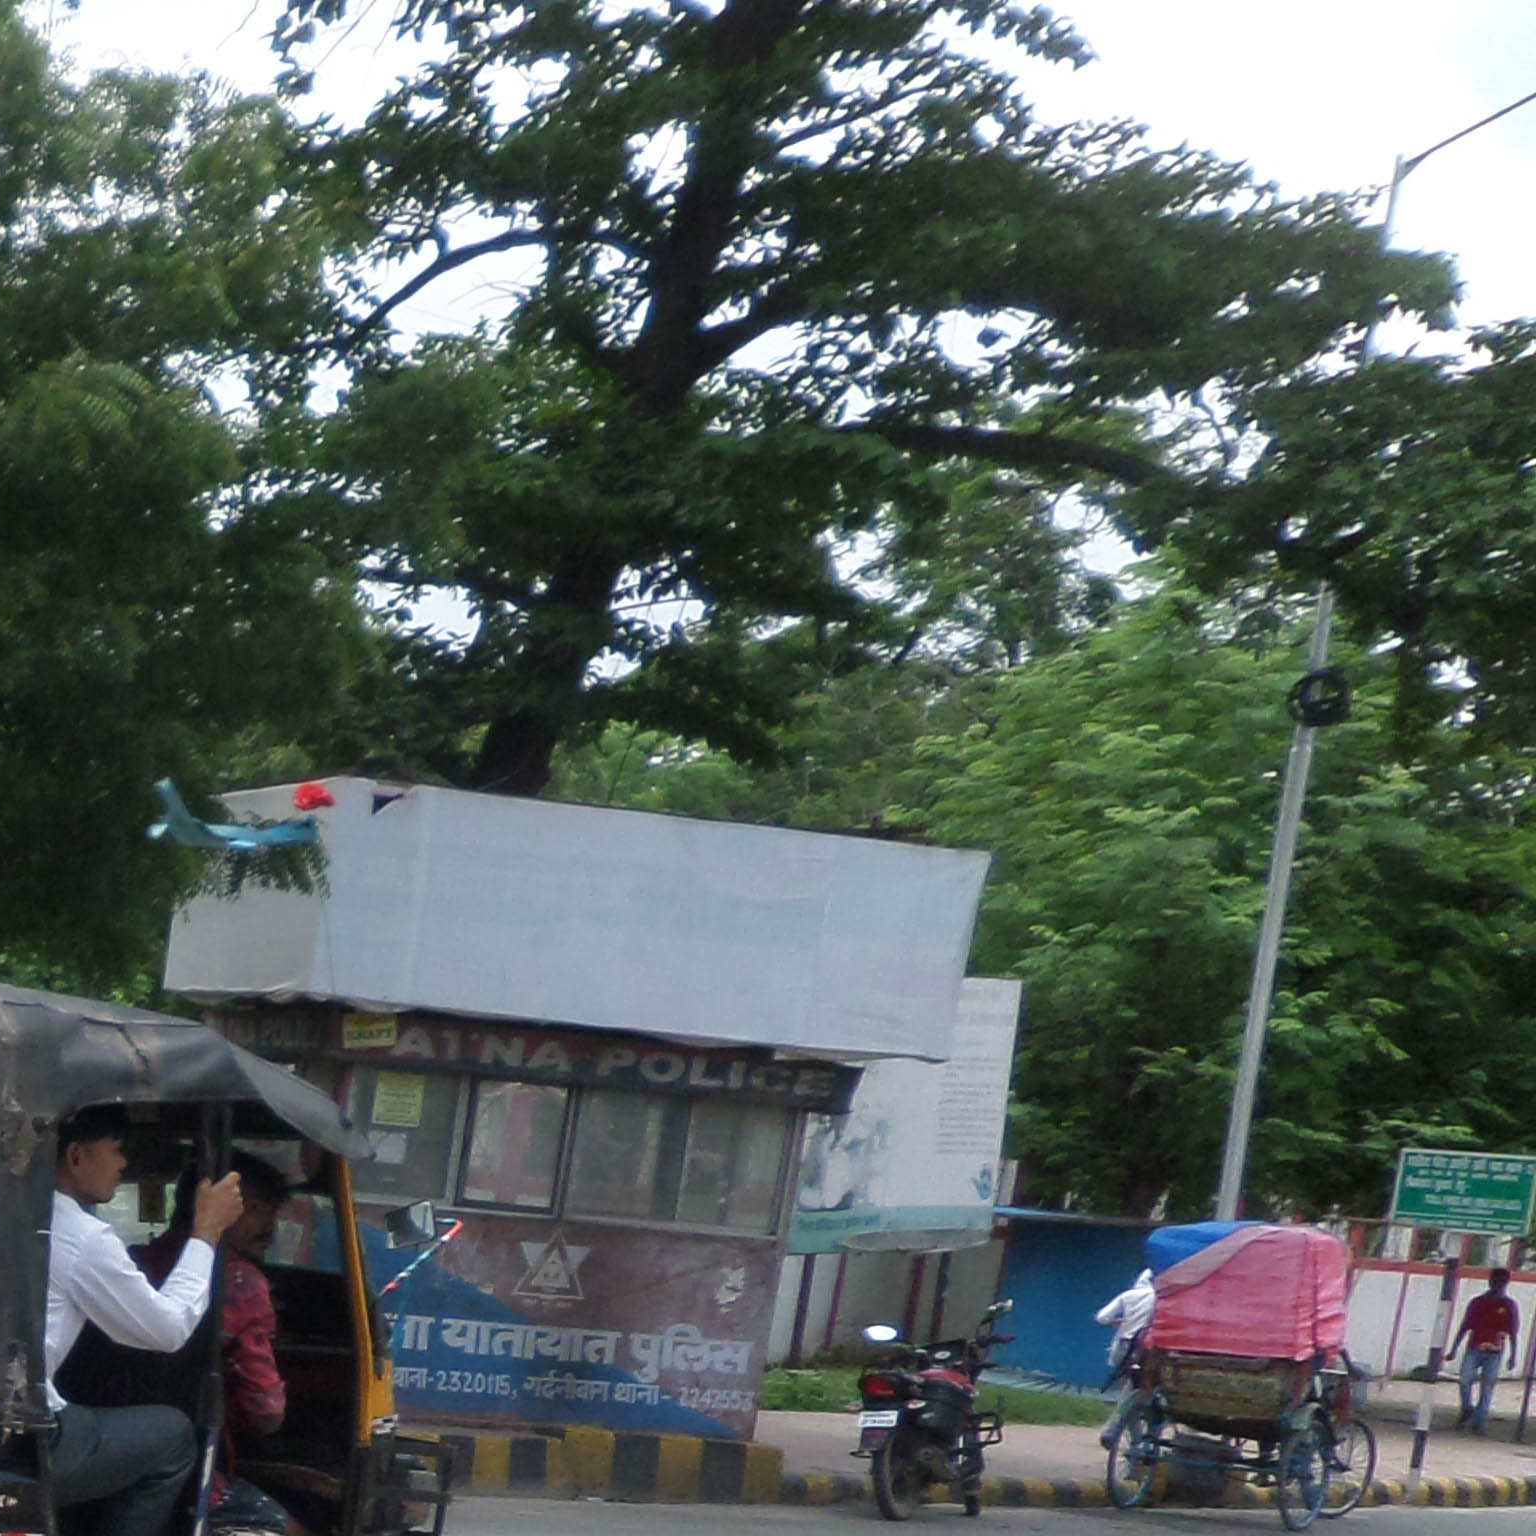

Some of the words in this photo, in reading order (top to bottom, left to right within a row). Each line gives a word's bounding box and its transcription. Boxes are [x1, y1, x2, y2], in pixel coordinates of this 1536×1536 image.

[392, 1026, 574, 1074] ATNA
[596, 1045, 838, 1100] POLICE
[440, 1315, 626, 1366] यातायात
[630, 1321, 757, 1384] पुलिस
